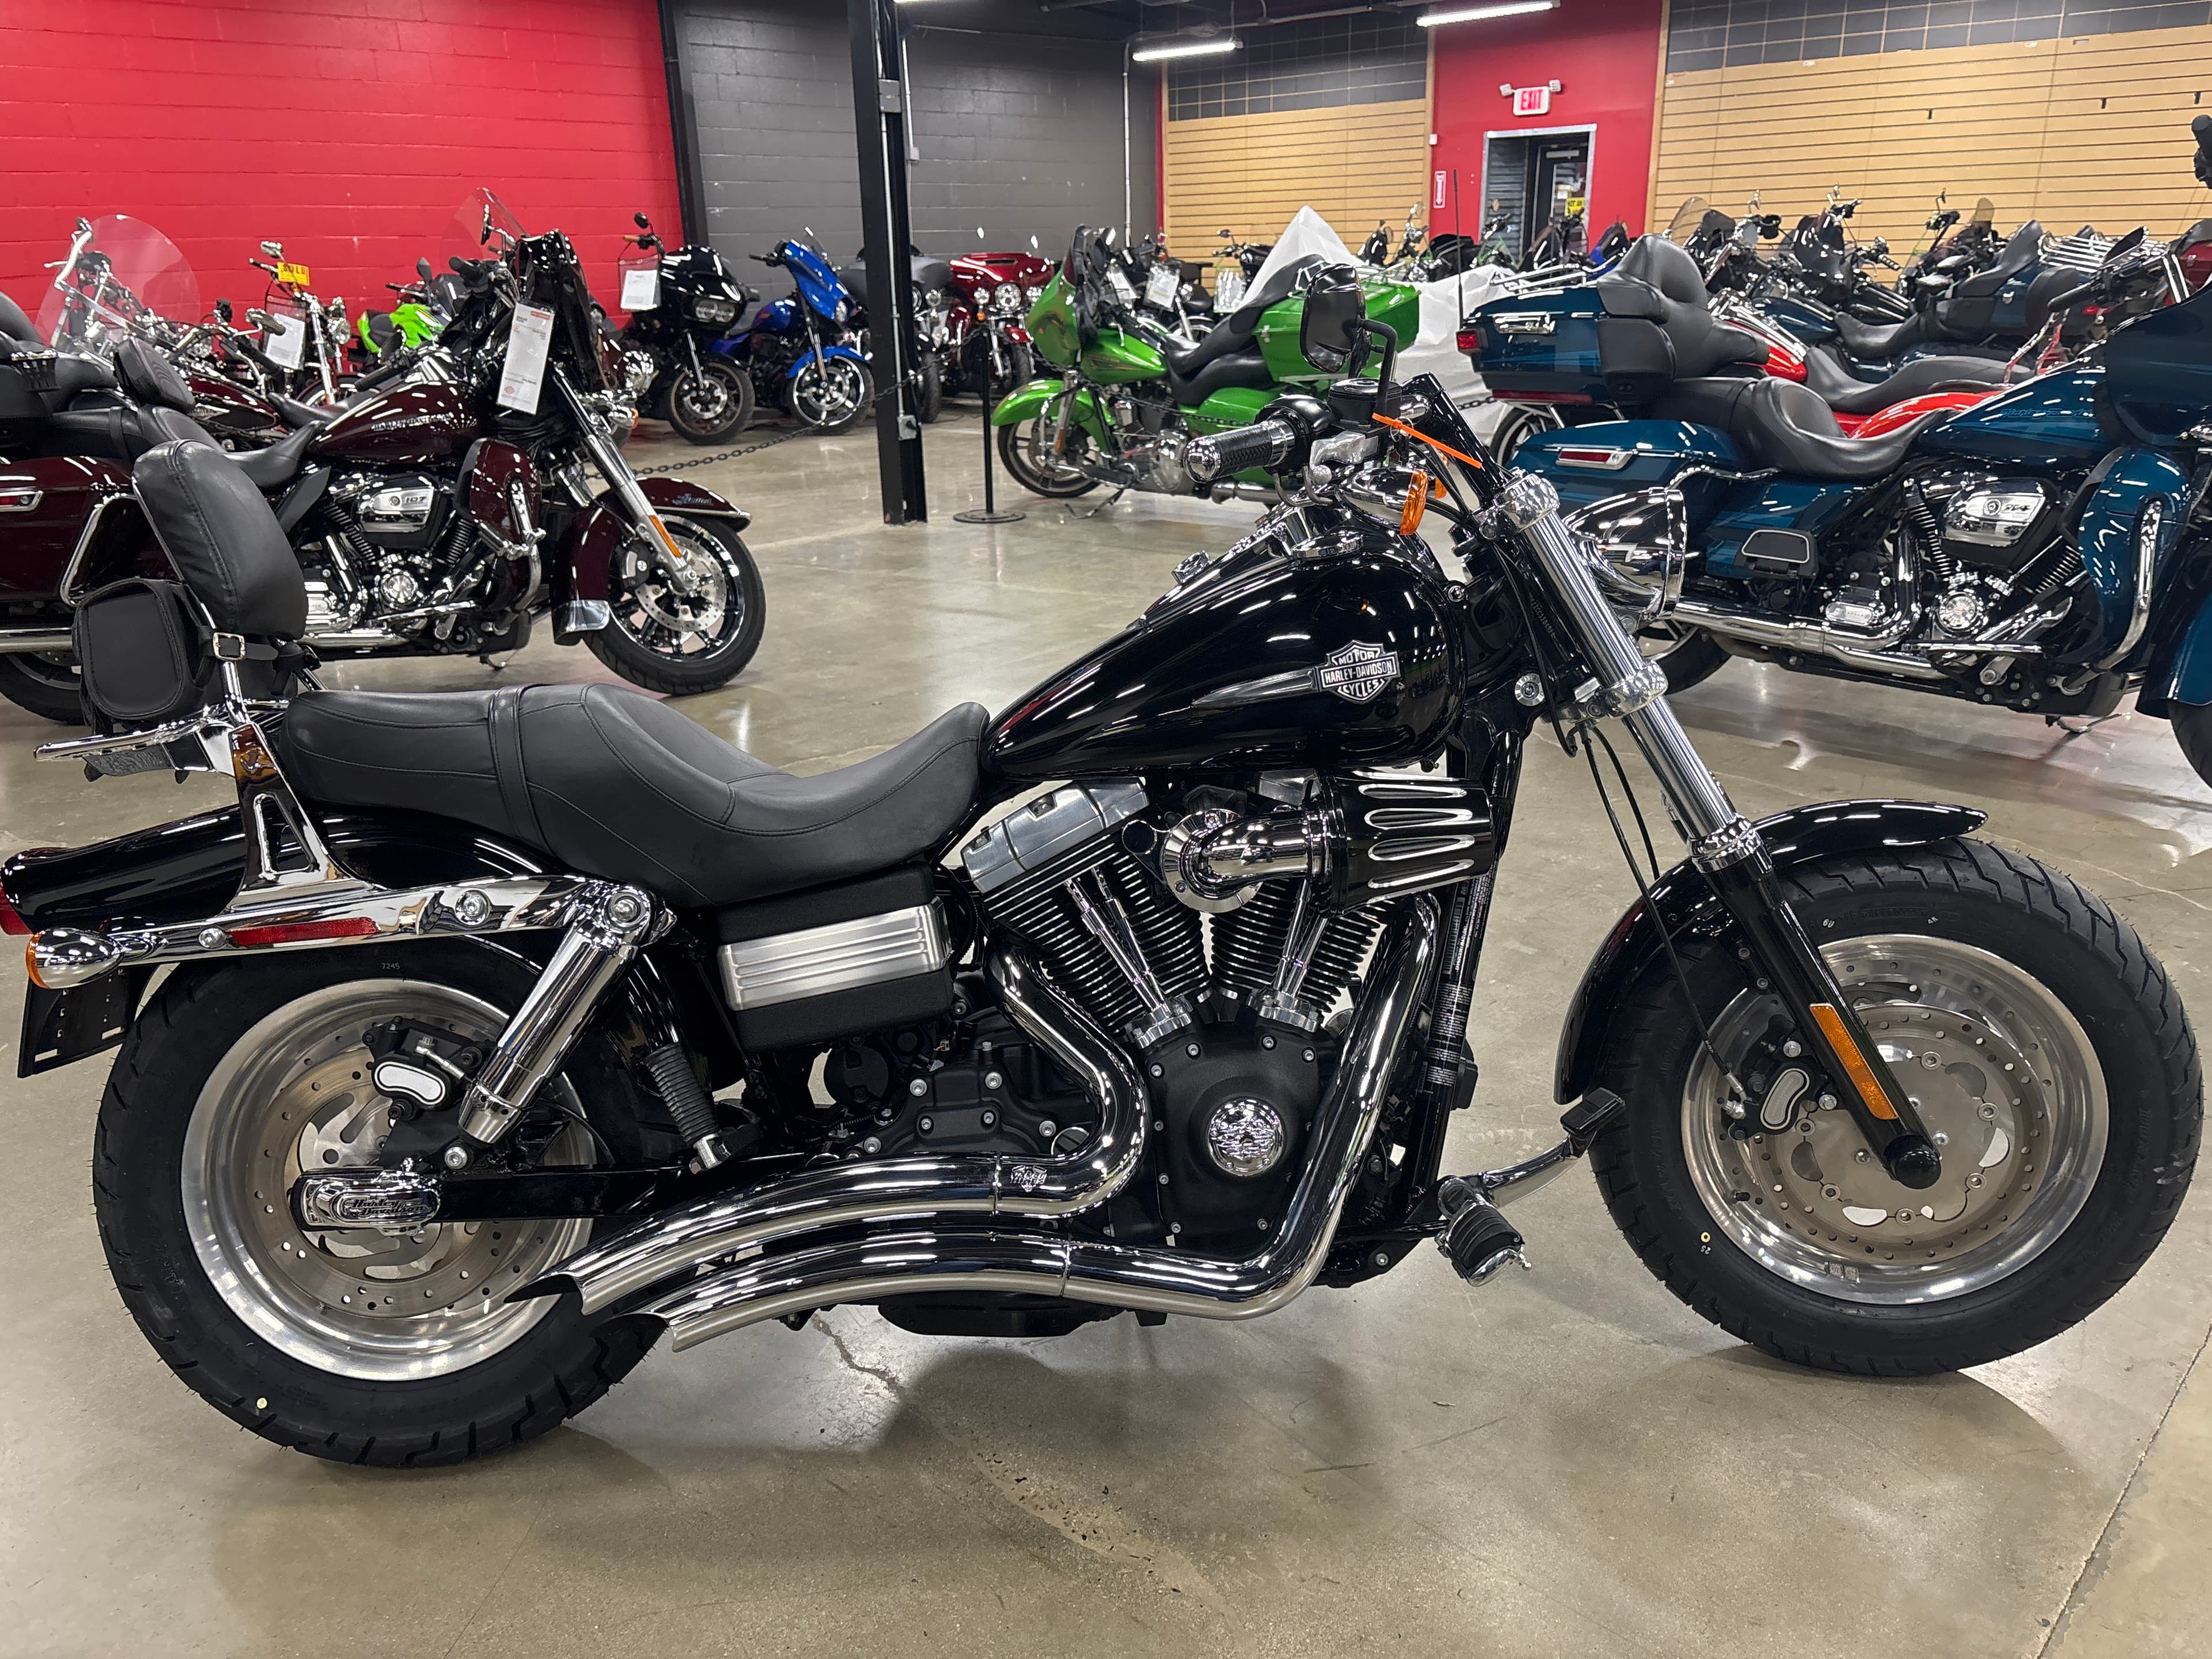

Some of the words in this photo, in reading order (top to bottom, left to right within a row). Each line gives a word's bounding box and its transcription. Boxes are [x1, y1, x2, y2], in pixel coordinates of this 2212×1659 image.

[1521, 89, 1543, 111] EXIT
[405, 496, 426, 504] 107
[1338, 648, 1375, 665] MOTOR
[1325, 660, 1392, 684] HARLEY-DAVIDSON
[1342, 679, 1379, 697] CYCLES
[1823, 919, 1835, 928] 6U
[349, 1197, 401, 1209] Harley
[359, 1204, 424, 1217] Davidson
